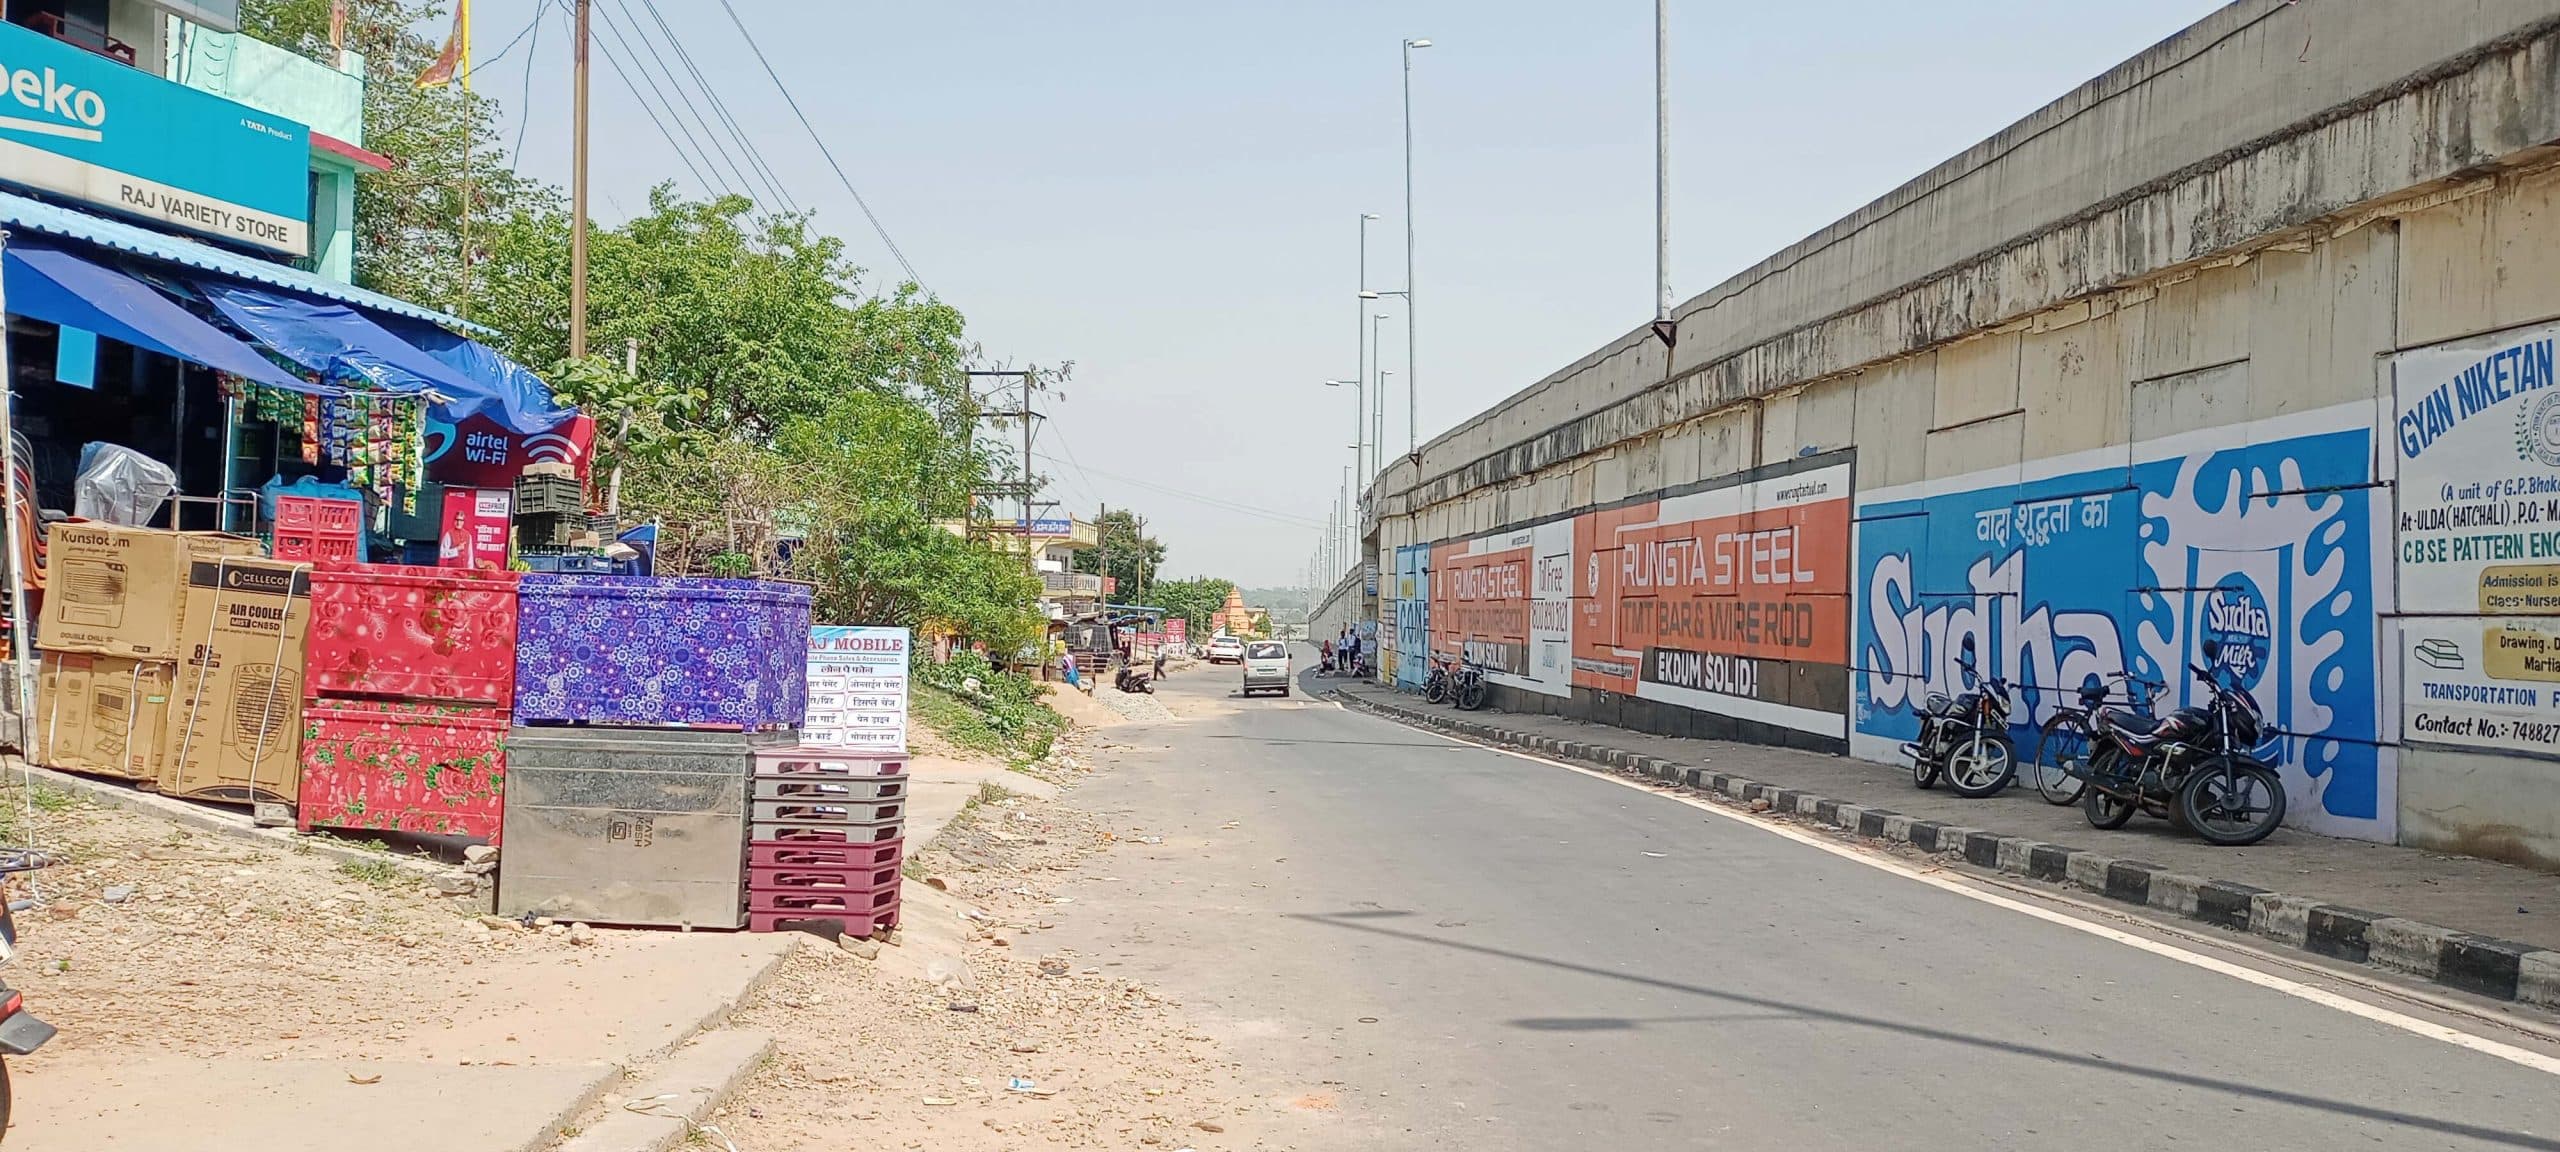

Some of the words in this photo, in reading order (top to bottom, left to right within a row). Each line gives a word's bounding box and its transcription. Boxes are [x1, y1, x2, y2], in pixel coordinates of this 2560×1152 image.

[240, 118, 246, 126] A
[246, 119, 267, 134] TATA
[121, 184, 156, 209] RAJ
[160, 194, 232, 229] VARIETY
[235, 216, 288, 243] STORE
[2399, 383, 2455, 459] GYAN
[2453, 338, 2554, 421] NIKETAN
[464, 446, 507, 466] Wi-Fi
[466, 431, 509, 450] airtel
[2441, 482, 2454, 503] (A
[2459, 482, 2481, 500] unit
[2486, 480, 2502, 503] of
[1975, 507, 2012, 548] वादा
[2014, 498, 2074, 547] शुद्धता
[2081, 493, 2113, 529] का
[61, 530, 130, 548] Kunstocm
[2403, 538, 2447, 563] CBSE
[2453, 533, 2524, 562] PATTERN
[1621, 537, 1707, 588] RUNGTA
[1714, 525, 1815, 586] STEEL
[1454, 567, 1487, 599] RUNGTA
[1487, 564, 1524, 599] STEEL
[1538, 559, 1547, 593] Toll
[1548, 559, 1563, 593] Free
[2483, 575, 2543, 588] Admission
[2548, 574, 2559, 587] is
[230, 603, 247, 616] AIR
[248, 605, 284, 620] COOLER
[1621, 601, 1657, 635] TMT
[1658, 602, 1692, 637] BAR
[1708, 601, 1760, 644] WIRE
[1764, 602, 1813, 648] ROD
[2208, 591, 2269, 638] Sudha
[808, 637, 828, 650] AJ
[834, 637, 903, 651] MOBILE
[1867, 549, 2131, 726] Sudha
[2214, 644, 2256, 668] Milk
[1657, 651, 1701, 687] EKDUM
[1705, 655, 1759, 698] SOLID!
[2422, 682, 2537, 707] TRANSPORTATION
[2415, 713, 2472, 736] Contact
[2512, 721, 2560, 744] 748827
[644, 817, 654, 848] TATA
